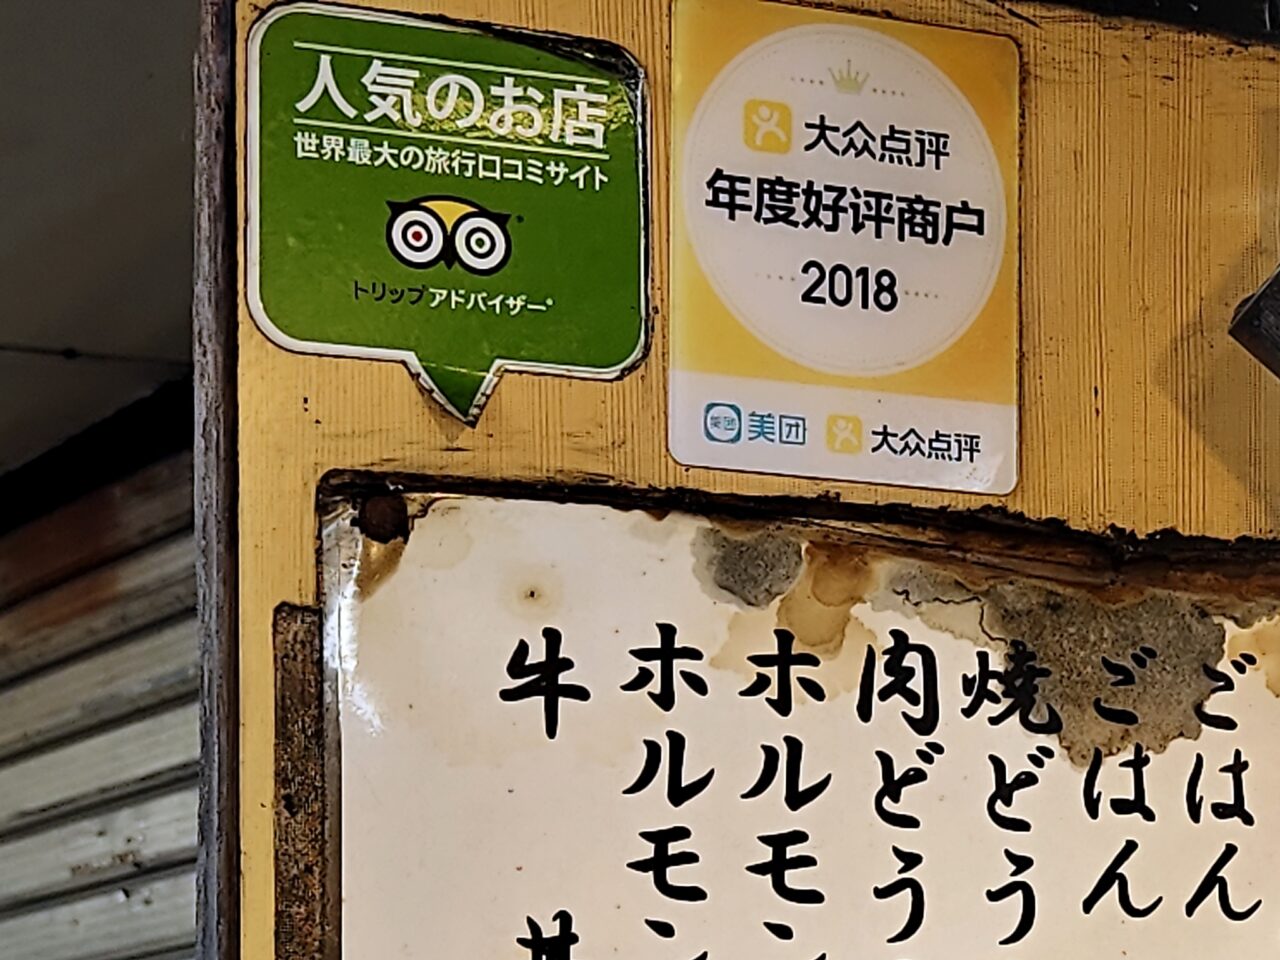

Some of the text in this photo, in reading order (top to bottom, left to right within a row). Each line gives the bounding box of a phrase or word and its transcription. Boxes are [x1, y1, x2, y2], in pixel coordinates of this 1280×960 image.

[295, 54, 609, 148] 人気のお店
[294, 132, 609, 190] 世界最大の旅行口コミサイト
[803, 114, 950, 170] 大众点评
[705, 168, 986, 246] 年度好评商户
[354, 280, 547, 316] トリップアドバイザー
[800, 260, 898, 312] 2018
[871, 425, 981, 464] 大众点评
